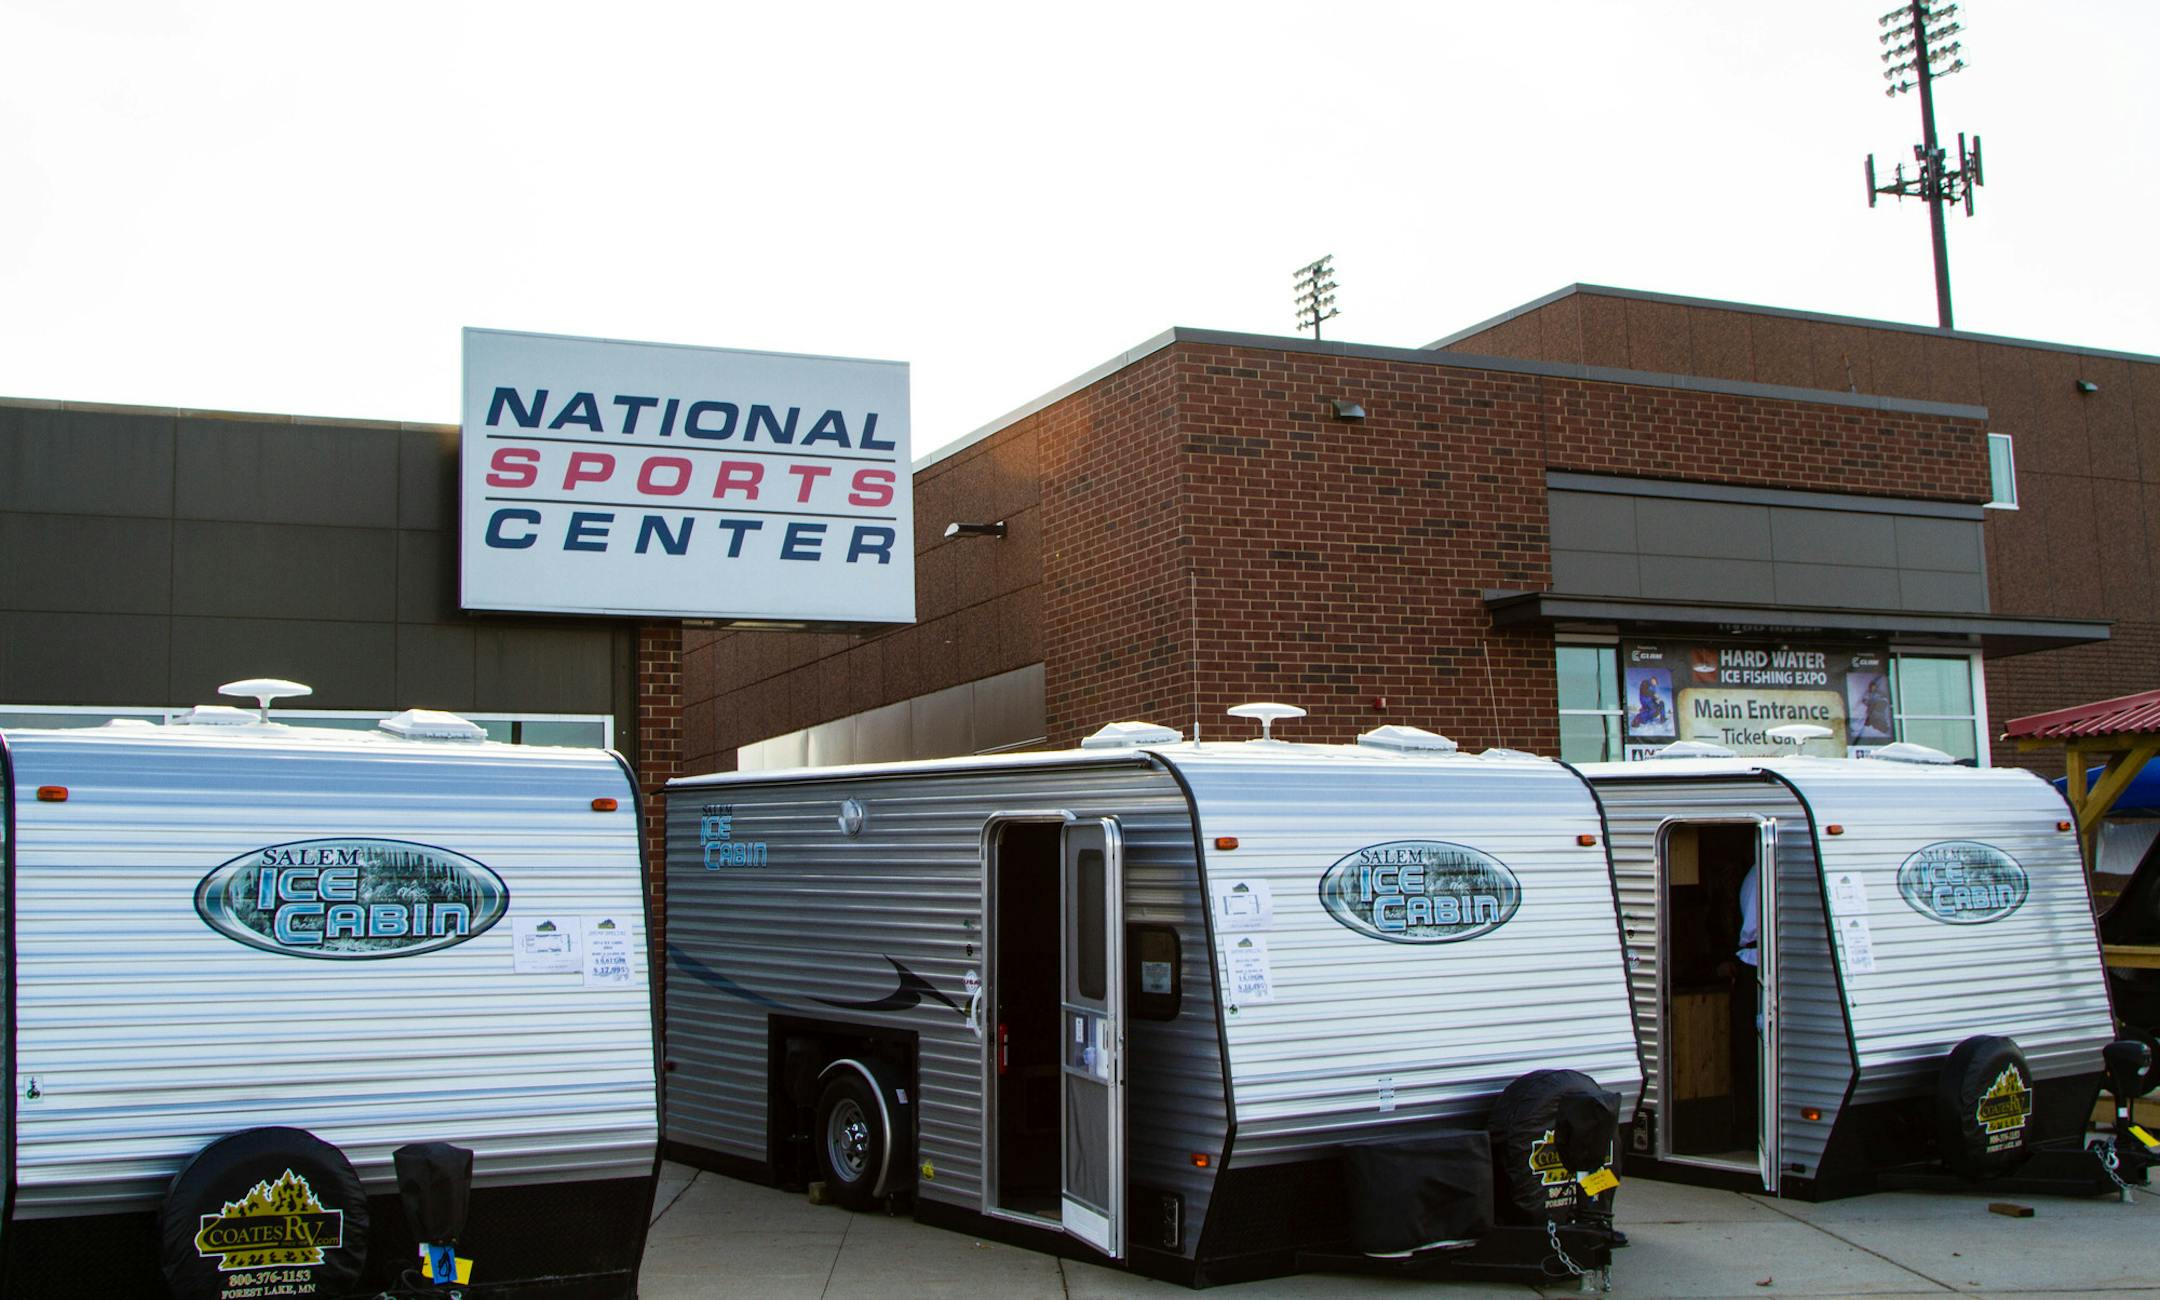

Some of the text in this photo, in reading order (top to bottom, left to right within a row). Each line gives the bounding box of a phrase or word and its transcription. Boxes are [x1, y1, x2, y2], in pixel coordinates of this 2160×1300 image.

[485, 386, 896, 451] NATIONAL
[485, 447, 897, 508] SPORTS
[484, 508, 897, 564] CENTER
[1720, 650, 1825, 669] HARD WATER
[1721, 670, 1827, 685] ICE FISHING EXPO
[1694, 699, 1829, 720] Main Entrance
[1722, 728, 1767, 745] Ticket
[701, 816, 732, 845] ICE
[262, 849, 362, 866] SALEM
[704, 841, 767, 871] CABIN
[1360, 850, 1424, 864] SALEM
[258, 867, 359, 910] ICE
[1360, 865, 1425, 902] ICE
[1920, 862, 1964, 892] ICE
[1373, 895, 1500, 932] CABIN
[1932, 883, 2017, 916] CABIN
[274, 902, 471, 945] CABIN
[221, 1284, 316, 1300] FOREST LAKE, MN
[229, 1270, 312, 1287] 800-376-1153
